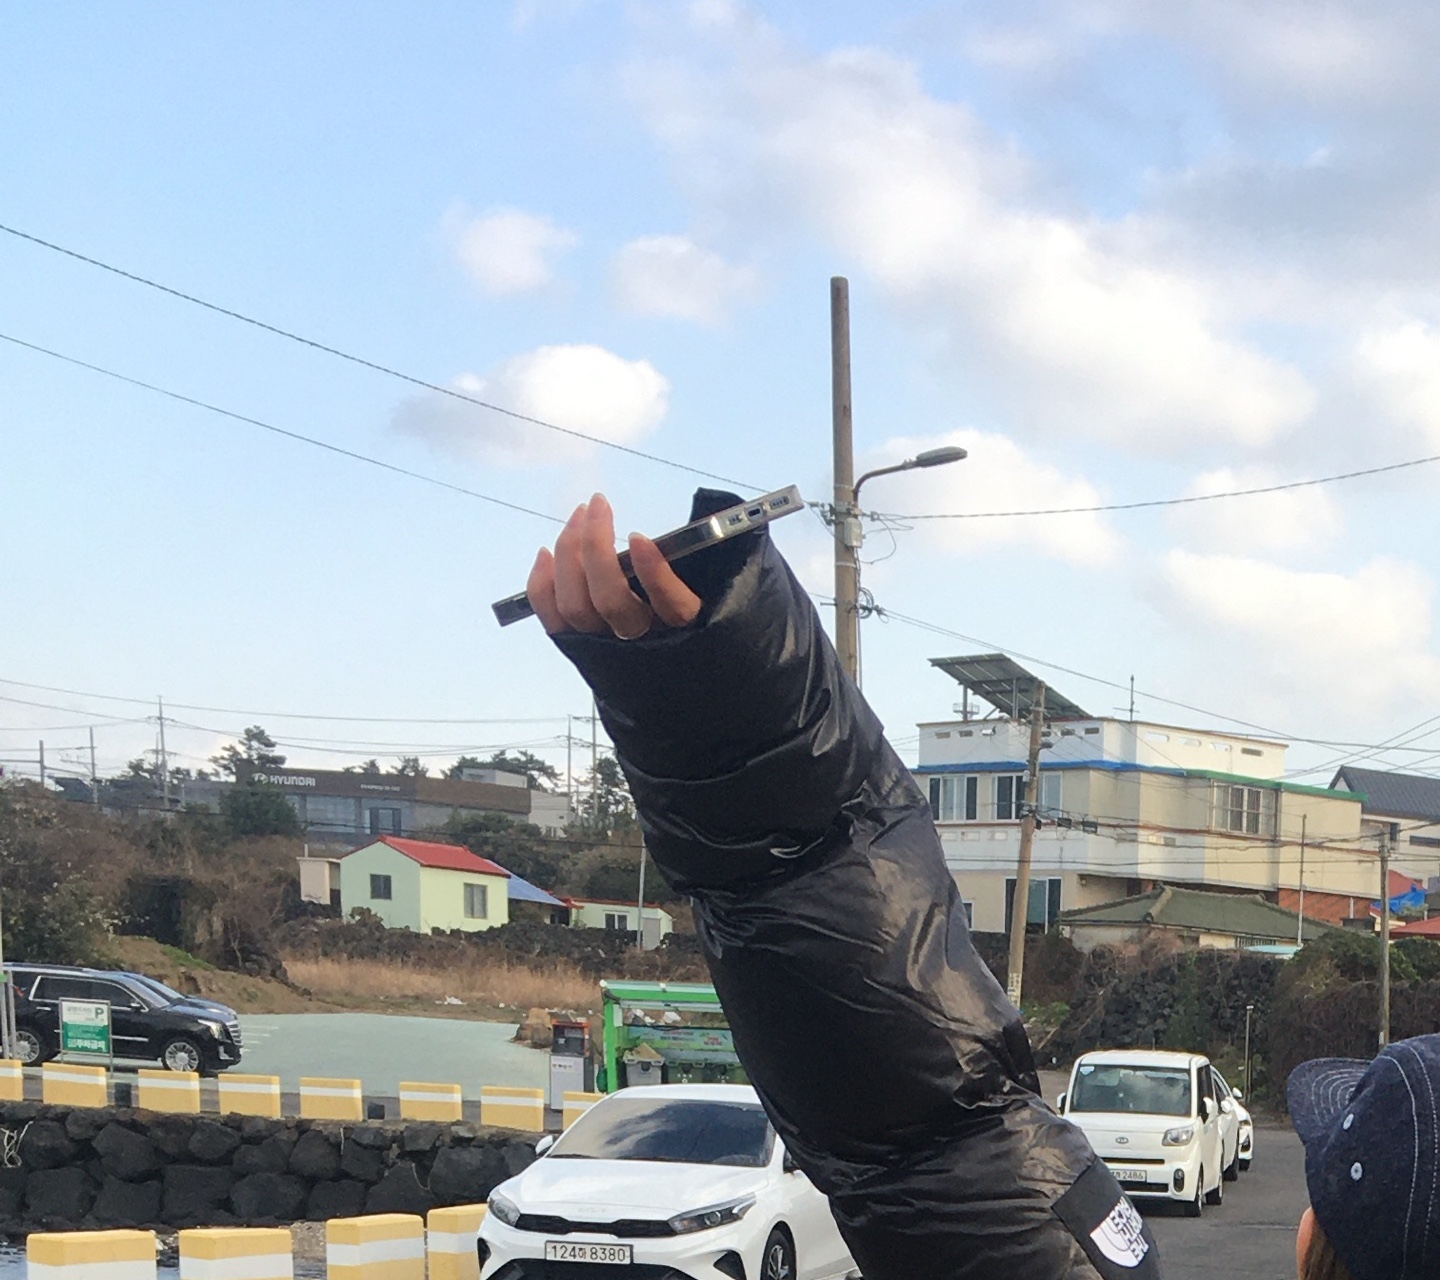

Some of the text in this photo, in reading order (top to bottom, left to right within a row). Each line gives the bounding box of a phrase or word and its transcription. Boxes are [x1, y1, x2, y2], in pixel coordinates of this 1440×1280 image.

[270, 775, 315, 786] HYUNDAI
[95, 1007, 104, 1019] P
[1130, 1234, 1149, 1262] THE
